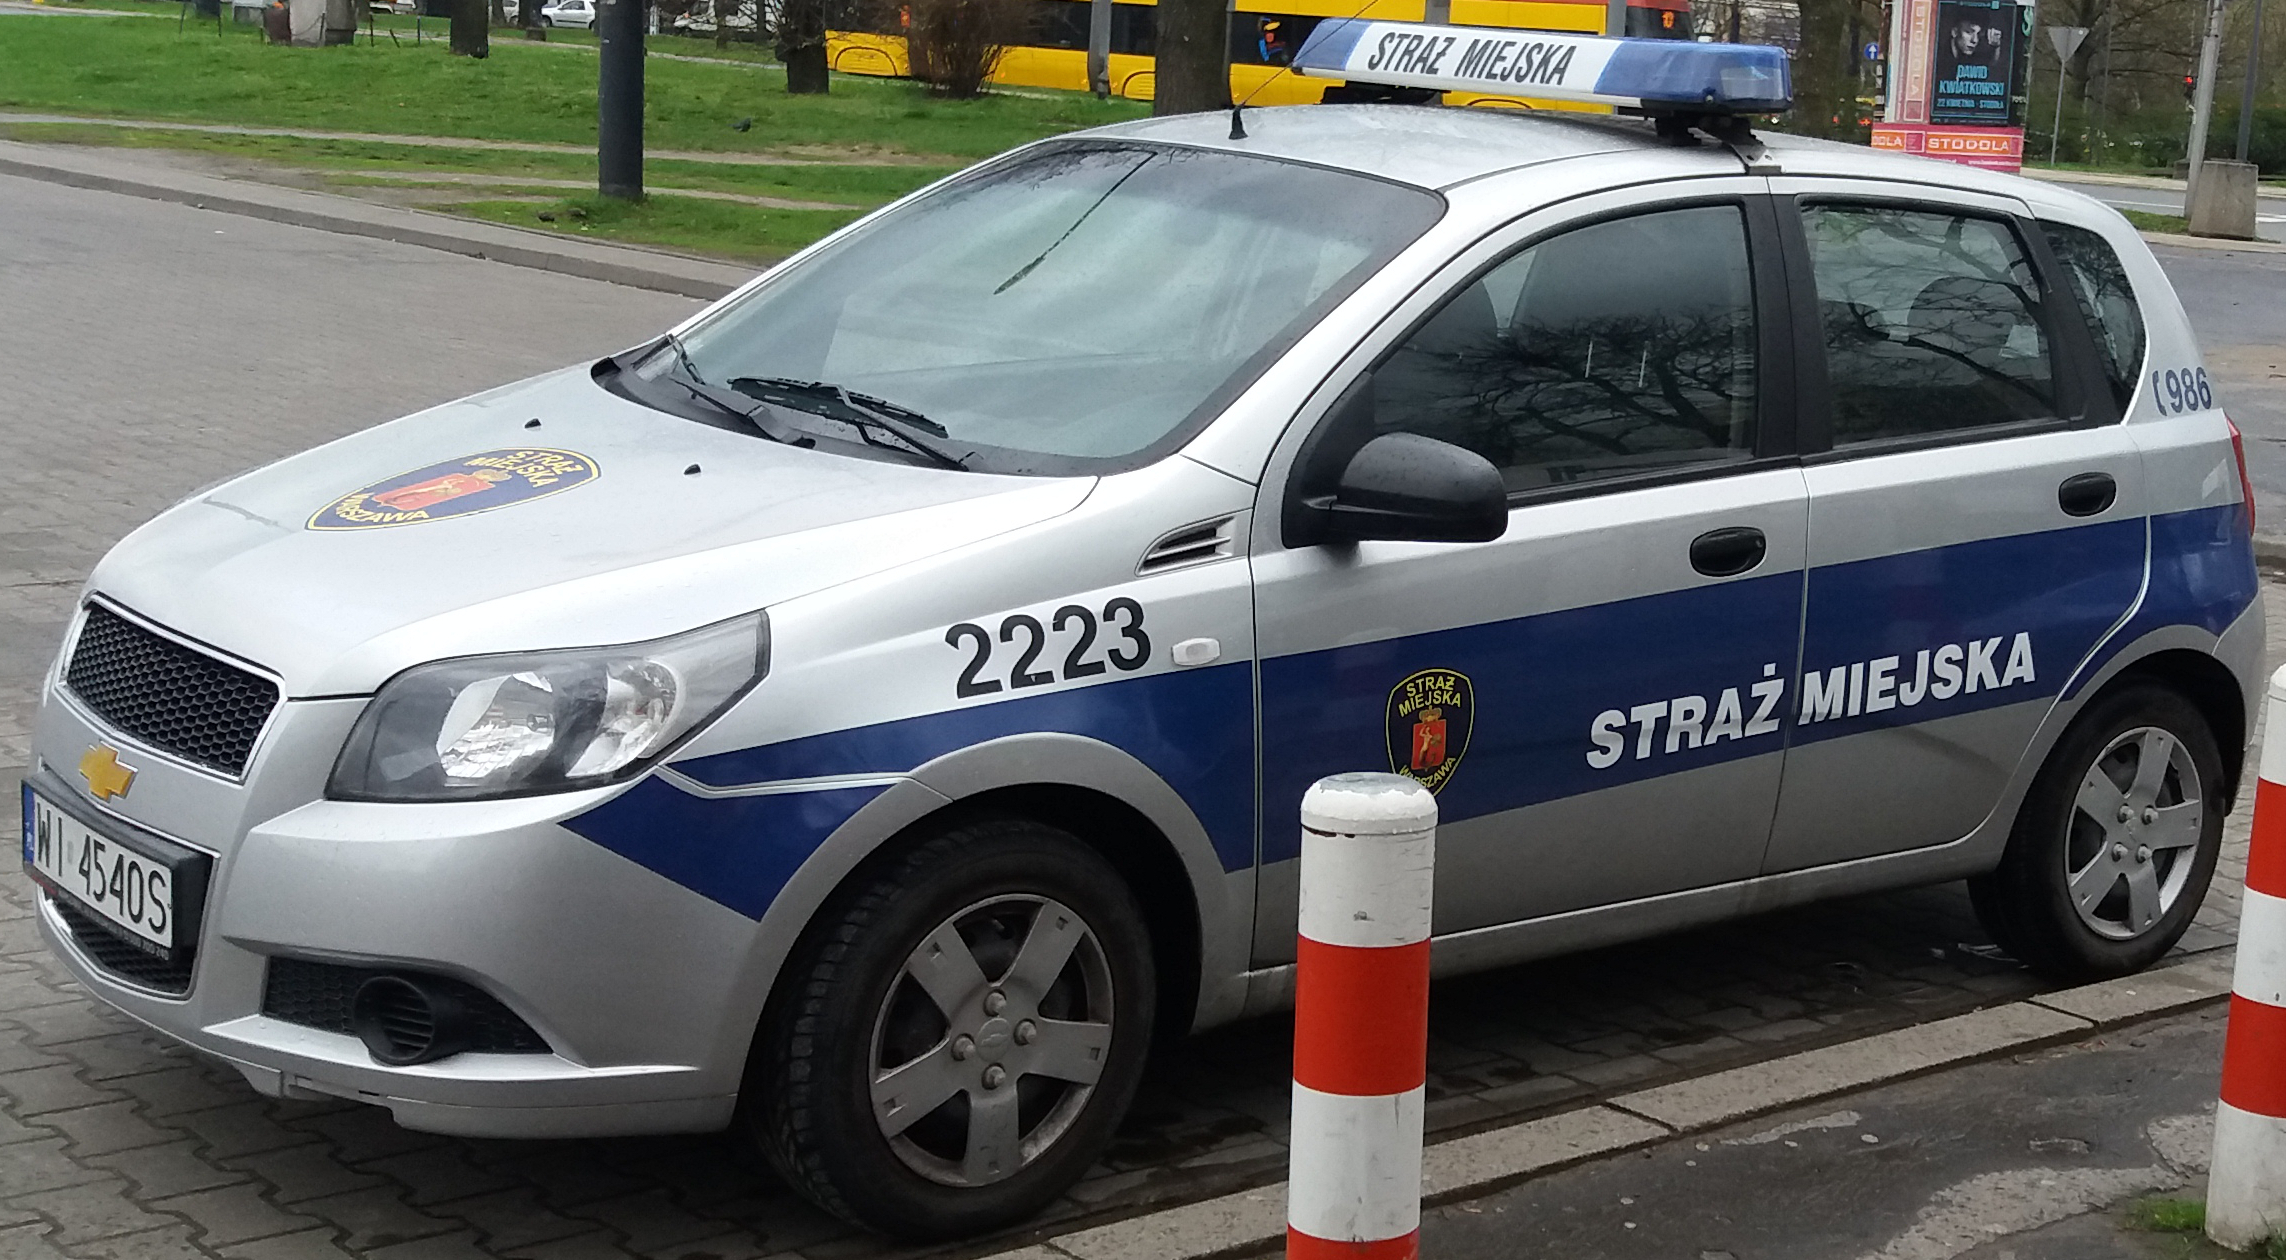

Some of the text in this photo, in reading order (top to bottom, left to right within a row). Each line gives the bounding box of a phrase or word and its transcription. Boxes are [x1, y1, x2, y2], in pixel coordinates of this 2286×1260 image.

[1454, 38, 1577, 86] MIEJSKA
[1957, 64, 1988, 79] DAWID
[1939, 80, 2005, 96] KWIATKOWSKI
[1928, 138, 2009, 151] STODOLA
[2165, 366, 2212, 414] 986
[464, 456, 560, 489] MIEJSKA
[335, 491, 430, 523] WARSZAWA
[944, 596, 1152, 699] 2223
[1398, 690, 1462, 718] MIEJSKA
[1586, 631, 2036, 770] STRAŻ MIEJSKA
[36, 801, 63, 877] WI
[78, 833, 168, 935] 4540S
